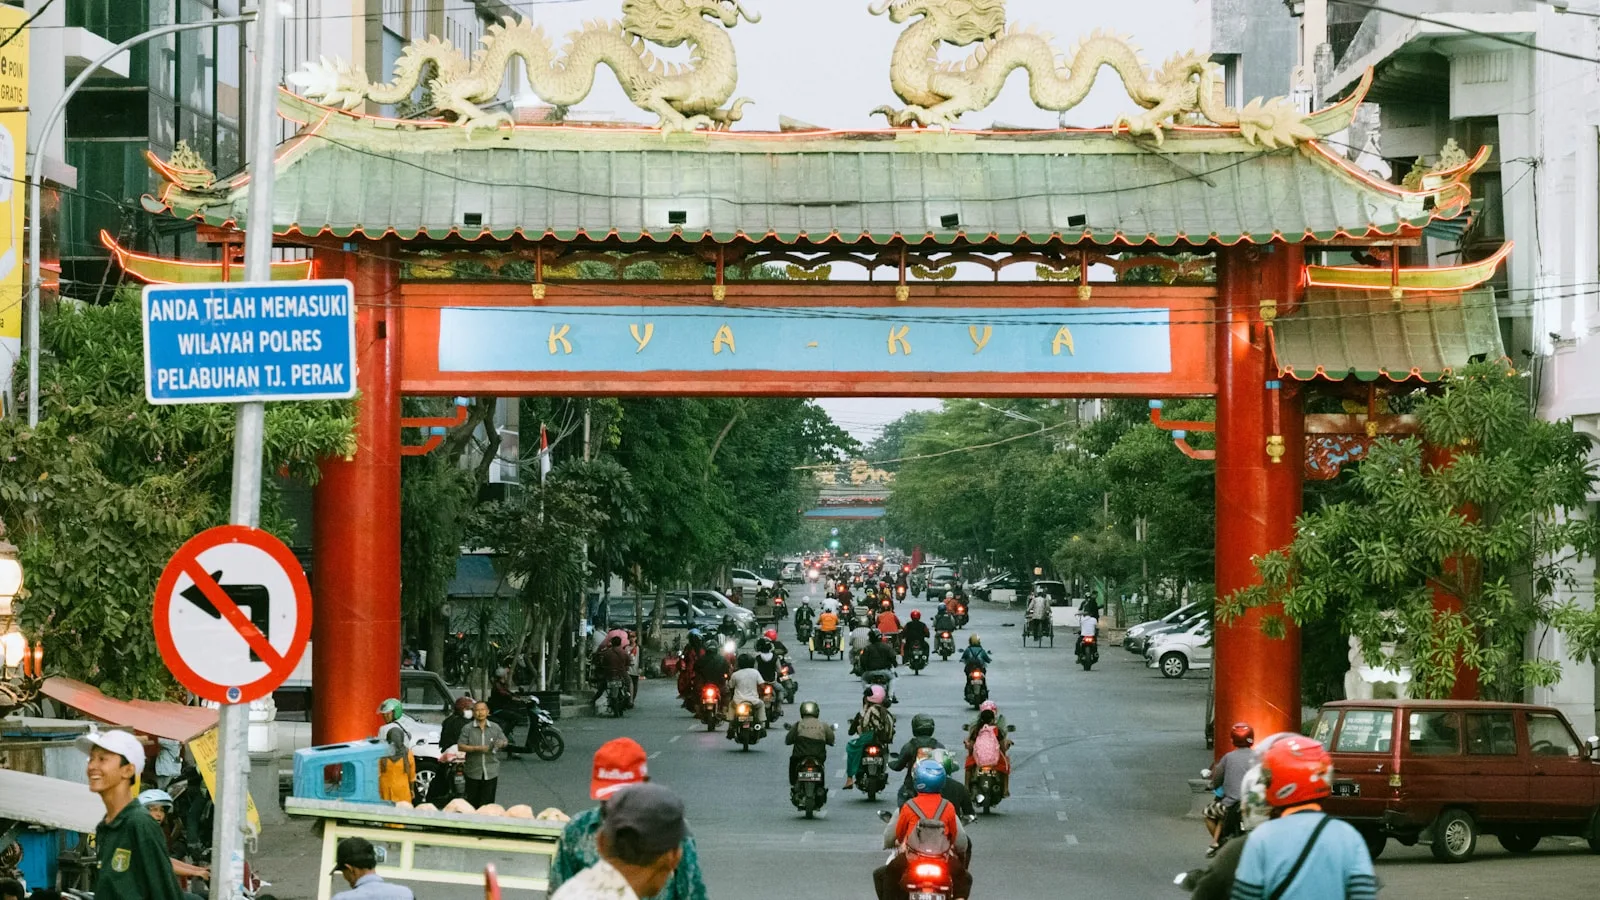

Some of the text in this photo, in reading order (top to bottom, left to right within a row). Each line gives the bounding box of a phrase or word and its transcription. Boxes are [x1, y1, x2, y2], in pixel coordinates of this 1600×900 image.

[1, 84, 23, 103] GRATIS
[150, 294, 347, 321] ANDA TELAH MEMASUKI
[177, 329, 322, 355] WILAYAH POLRES
[157, 363, 344, 390] PELABUHAN TJ. PERAK
